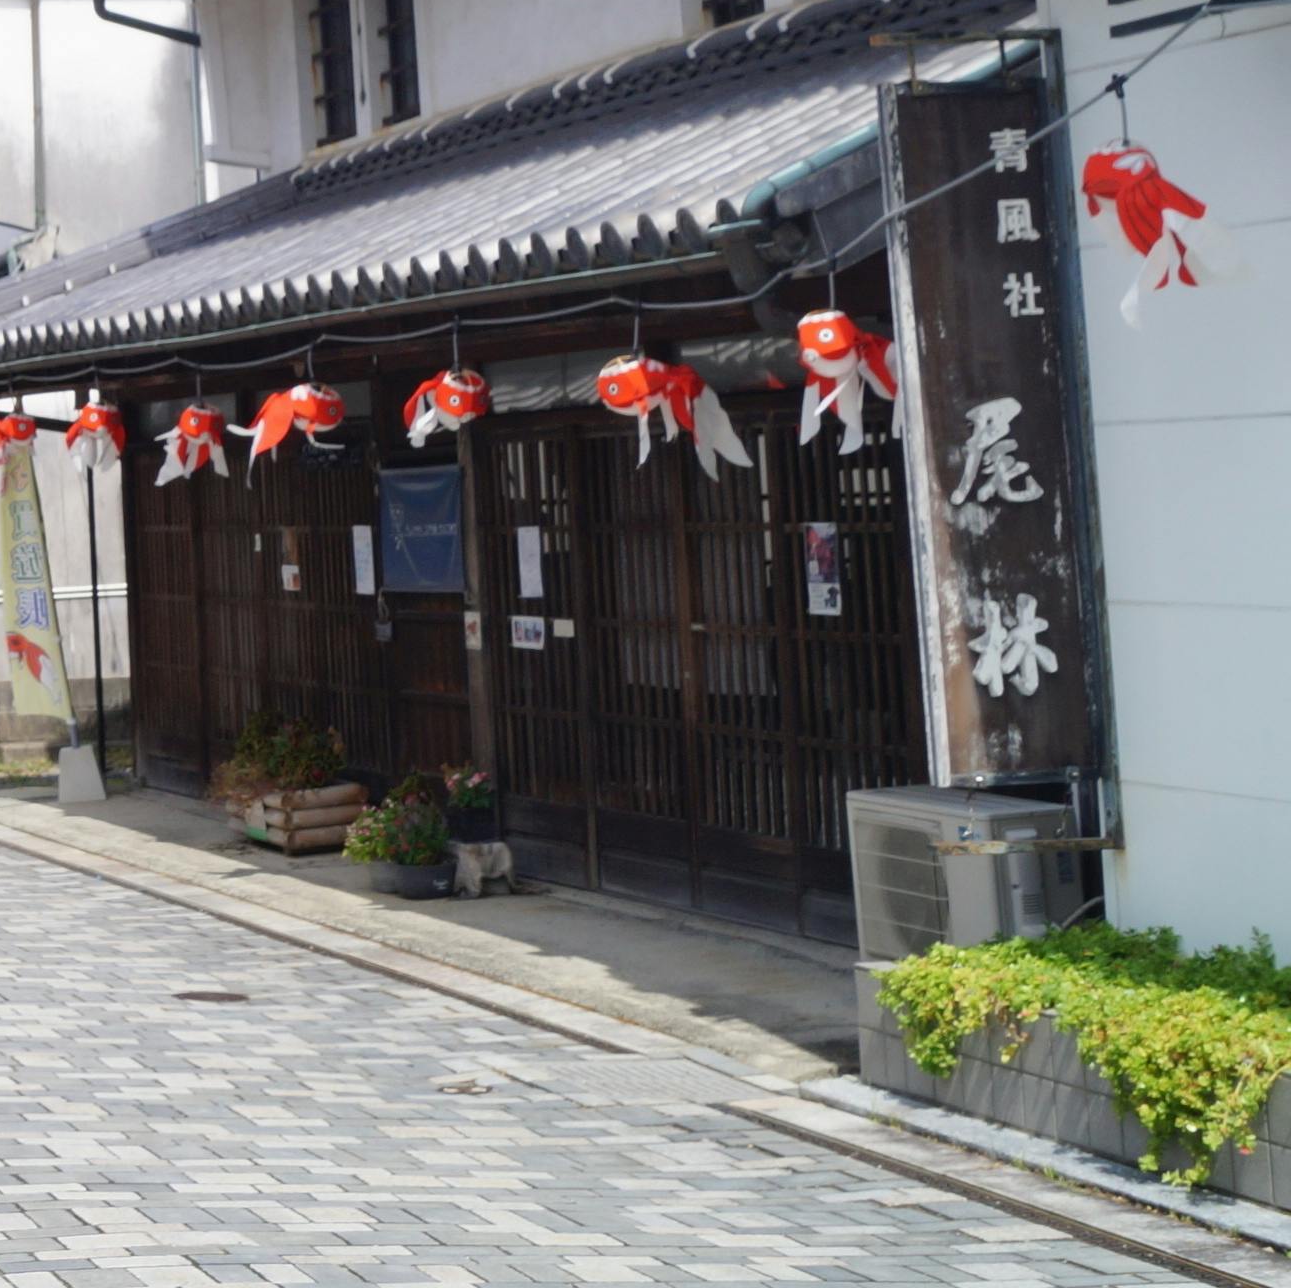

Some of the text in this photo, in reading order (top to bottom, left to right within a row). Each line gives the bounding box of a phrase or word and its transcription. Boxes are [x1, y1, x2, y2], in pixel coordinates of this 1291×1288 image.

[989, 128, 1045, 318] 青風社
[950, 397, 1058, 697] 尾林
